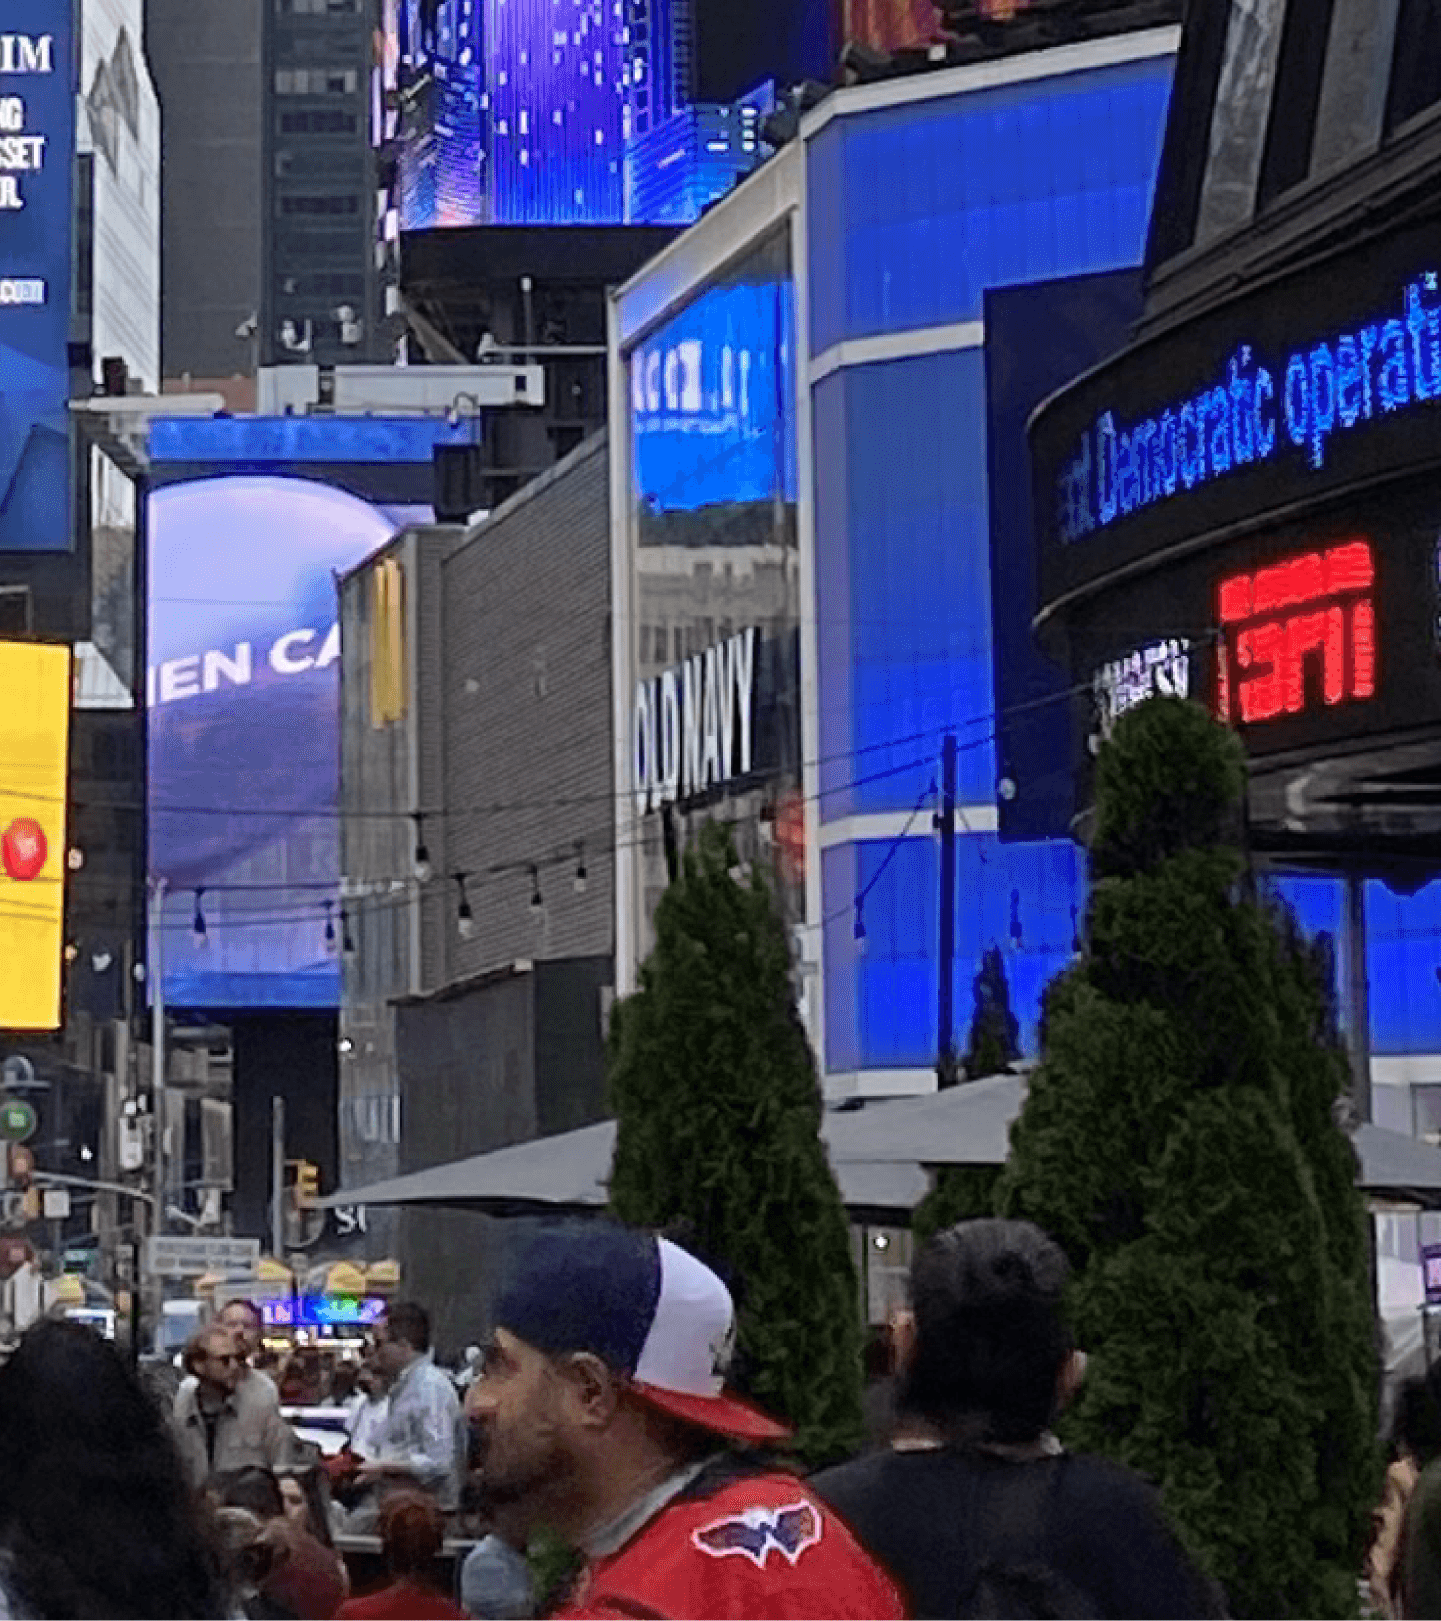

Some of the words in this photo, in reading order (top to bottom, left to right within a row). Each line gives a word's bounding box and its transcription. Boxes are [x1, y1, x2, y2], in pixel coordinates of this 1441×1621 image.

[1097, 344, 1276, 526] Democratic
[635, 670, 681, 816] OLD
[682, 626, 755, 799] NAVY
[1219, 540, 1376, 723] ESPN
